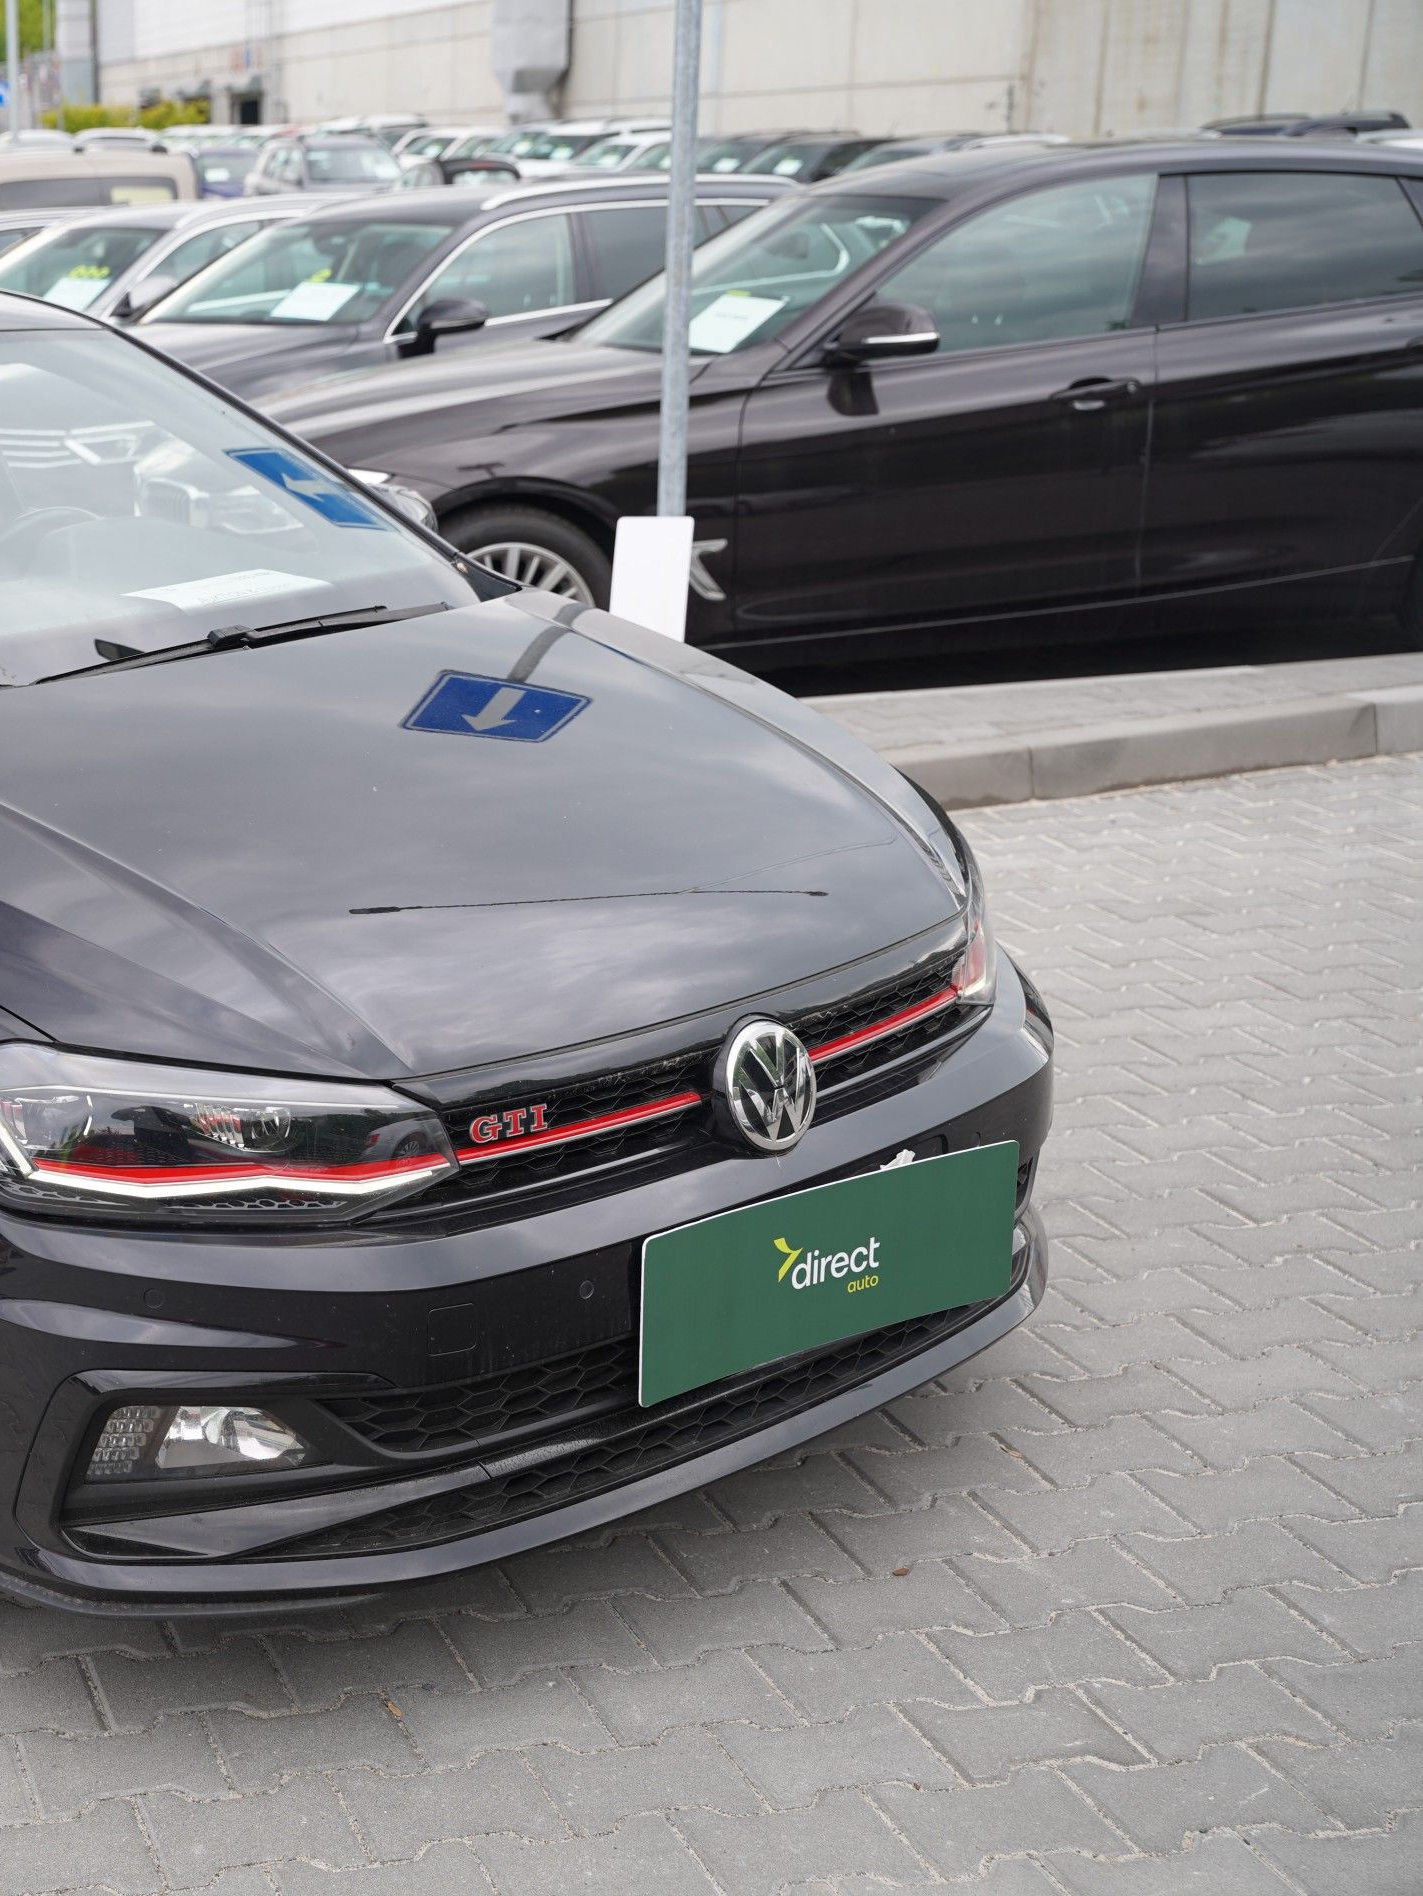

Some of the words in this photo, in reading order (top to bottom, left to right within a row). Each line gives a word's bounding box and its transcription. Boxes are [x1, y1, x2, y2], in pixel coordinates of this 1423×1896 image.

[469, 1102, 548, 1143] GTI
[791, 1236, 880, 1290] direct
[847, 1275, 879, 1293] auto
